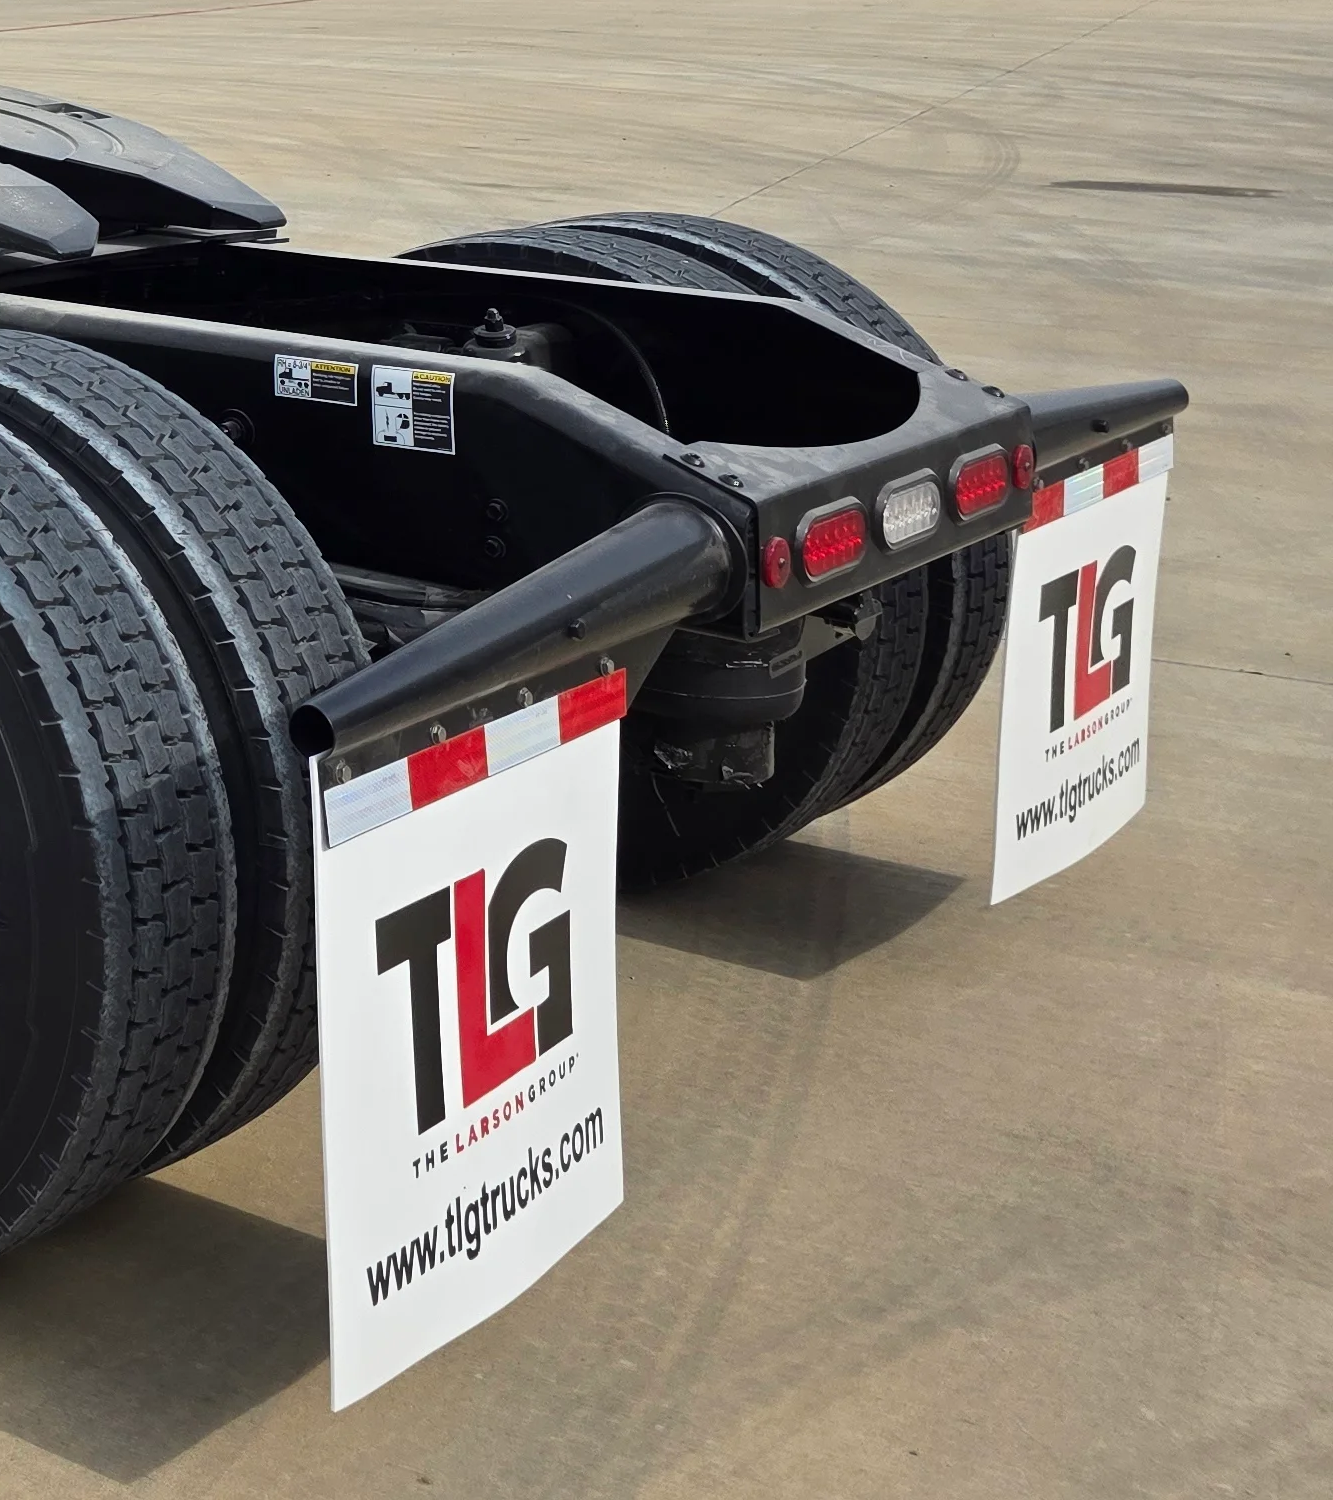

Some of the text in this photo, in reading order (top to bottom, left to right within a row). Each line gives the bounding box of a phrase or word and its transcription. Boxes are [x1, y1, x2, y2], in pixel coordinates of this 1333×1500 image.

[314, 363, 351, 373] ATTENTION
[419, 373, 451, 383] CAUTION
[279, 385, 310, 397] UNLADEN
[1038, 544, 1137, 734] TLG
[1044, 740, 1065, 763] THE
[1015, 737, 1140, 841] www.tlgtrucks.com
[375, 837, 574, 1135] TLG
[412, 1140, 449, 1179] THE
[366, 1107, 604, 1307] www.tlgtrucks.com
